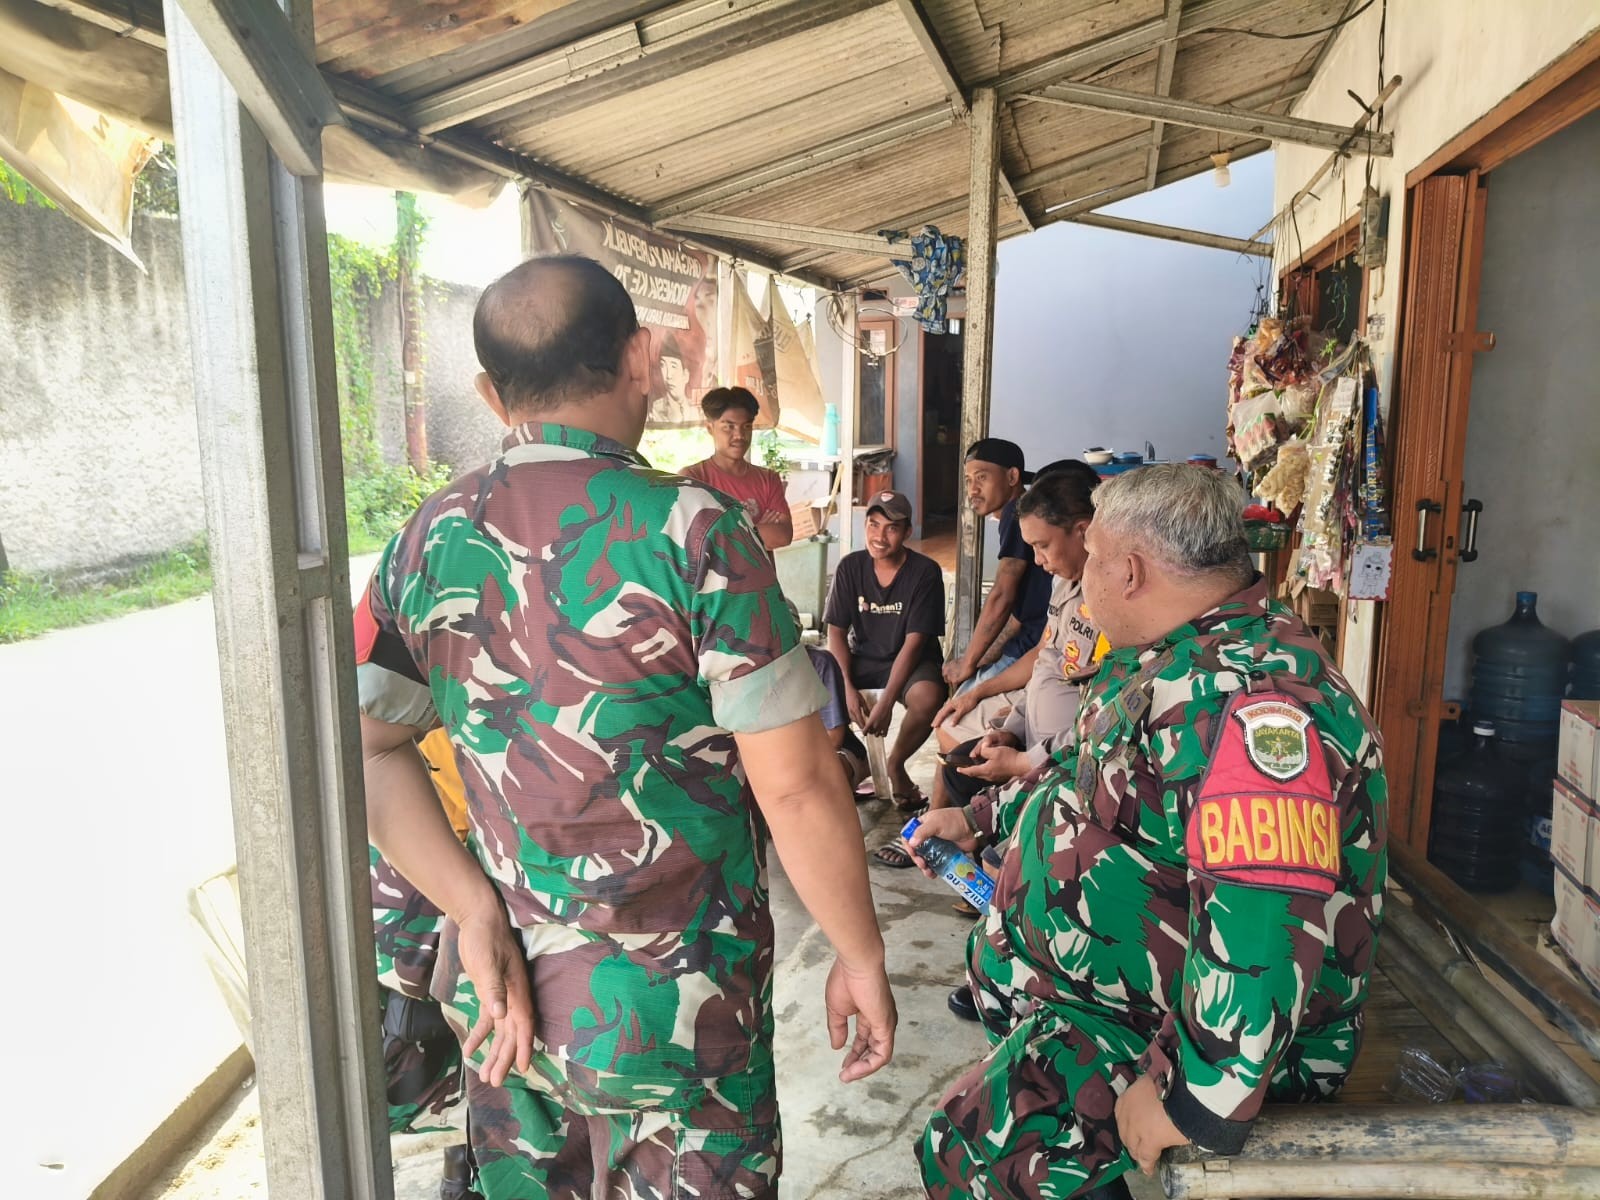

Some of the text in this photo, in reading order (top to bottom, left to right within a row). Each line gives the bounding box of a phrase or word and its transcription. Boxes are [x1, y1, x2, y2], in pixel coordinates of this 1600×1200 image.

[1069, 617, 1094, 641] POLRI
[1255, 727, 1299, 739] JAYAKARTA
[1201, 797, 1341, 872] BABINSA
[946, 872, 985, 907] mizone
